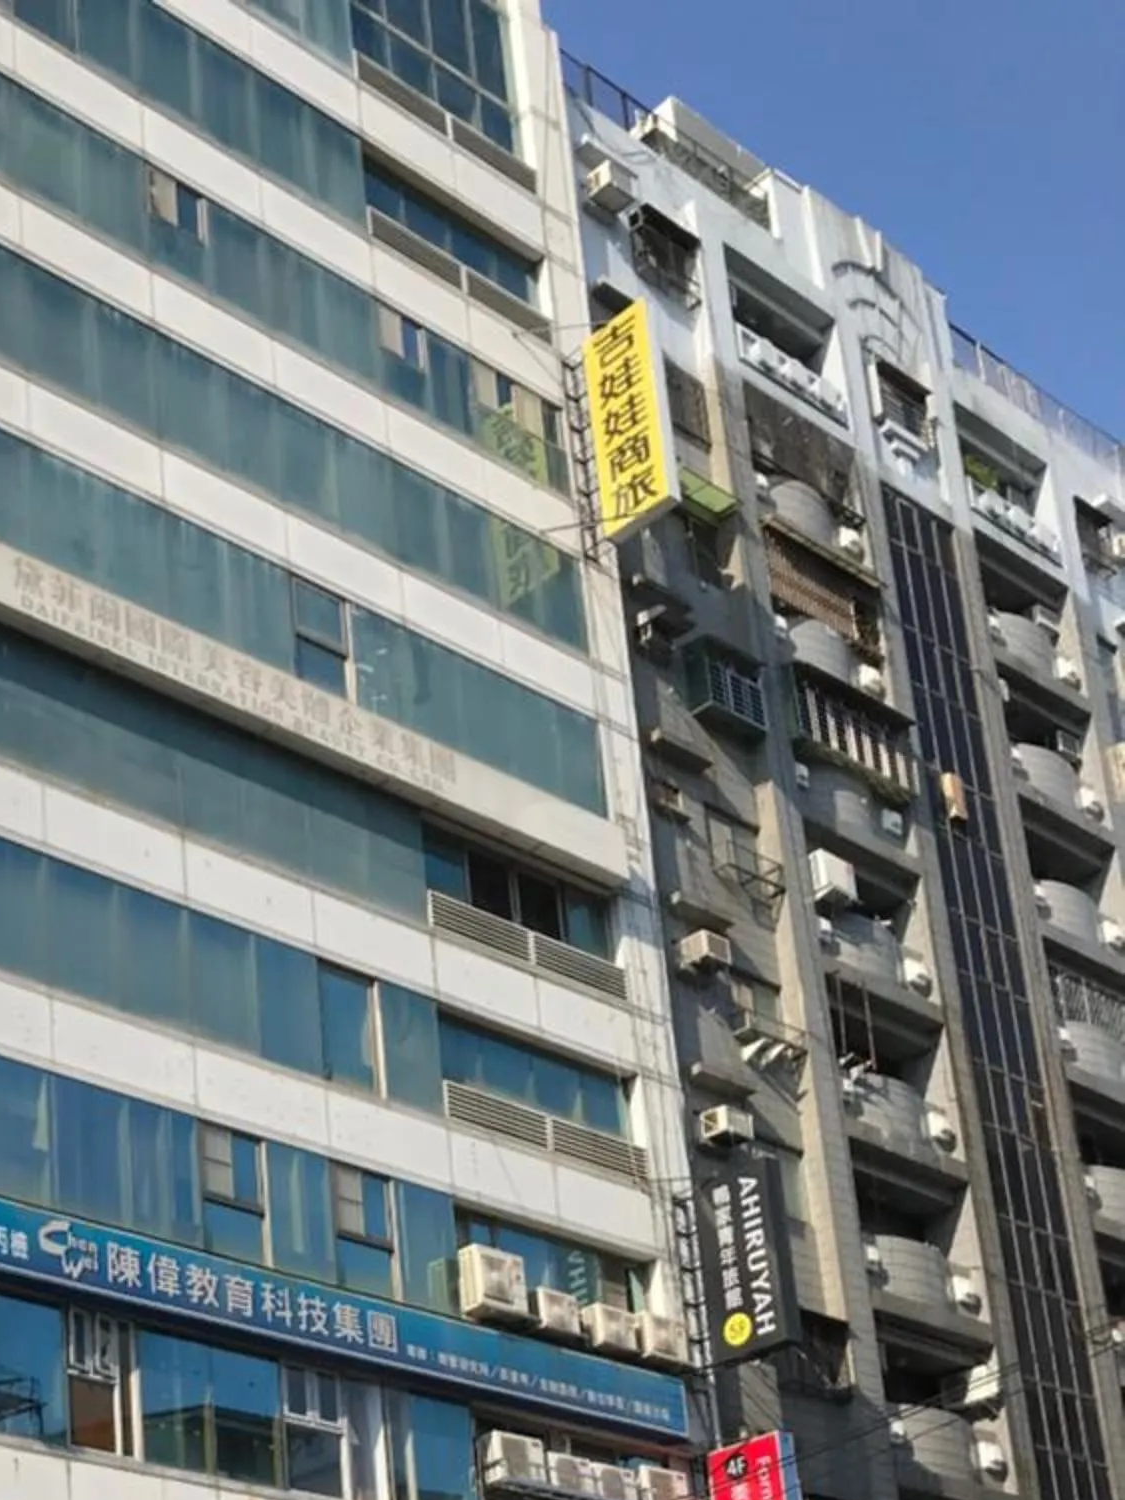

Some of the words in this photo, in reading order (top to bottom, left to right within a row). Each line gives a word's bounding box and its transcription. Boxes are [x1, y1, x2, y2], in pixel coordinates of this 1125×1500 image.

[593, 315, 658, 519] 吉娃娃商旅
[106, 1242, 398, 1354] 陳偉教育科技集團
[737, 1176, 777, 1336] AHIRUYAH
[726, 1456, 748, 1476] 4F
